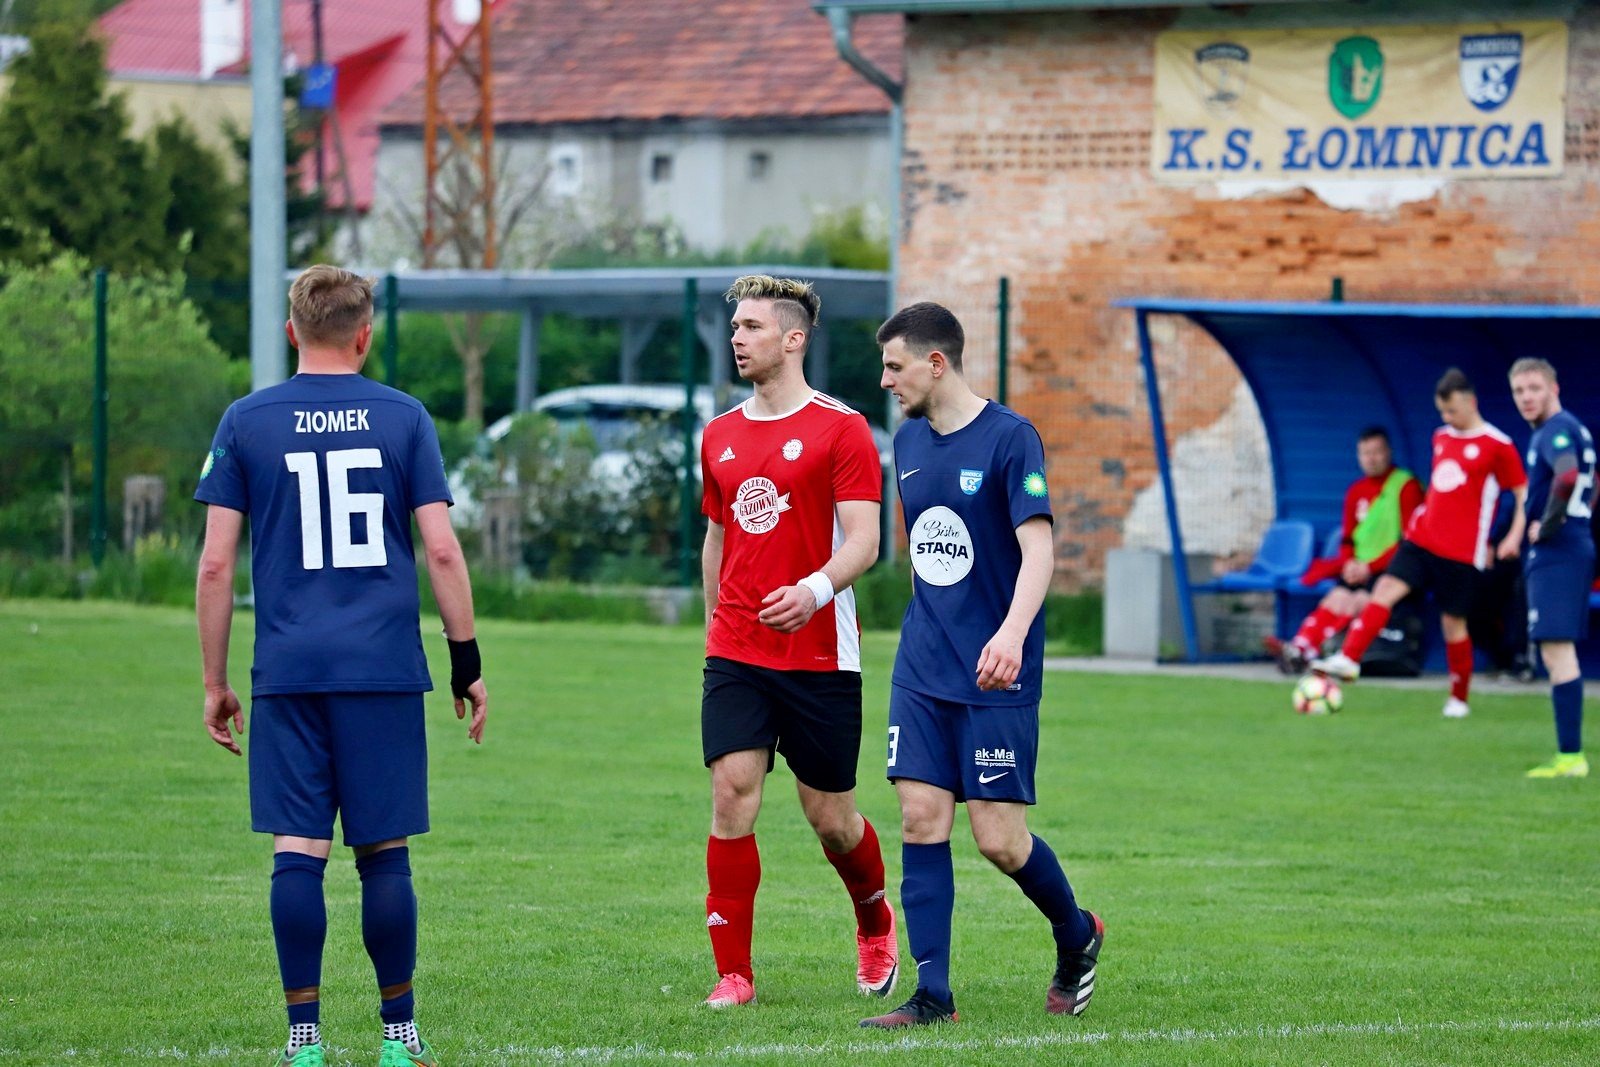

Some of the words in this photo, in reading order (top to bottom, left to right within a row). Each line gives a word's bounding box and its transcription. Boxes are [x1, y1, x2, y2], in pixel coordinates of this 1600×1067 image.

[1163, 127, 1262, 171] K.S.
[1282, 121, 1550, 170] ŁOMNICA
[294, 408, 370, 433] ZIOMEK
[740, 478, 773, 494] PIZZERIA
[284, 448, 388, 570] 16
[923, 520, 960, 539] Bistro
[916, 542, 969, 560] STACJA
